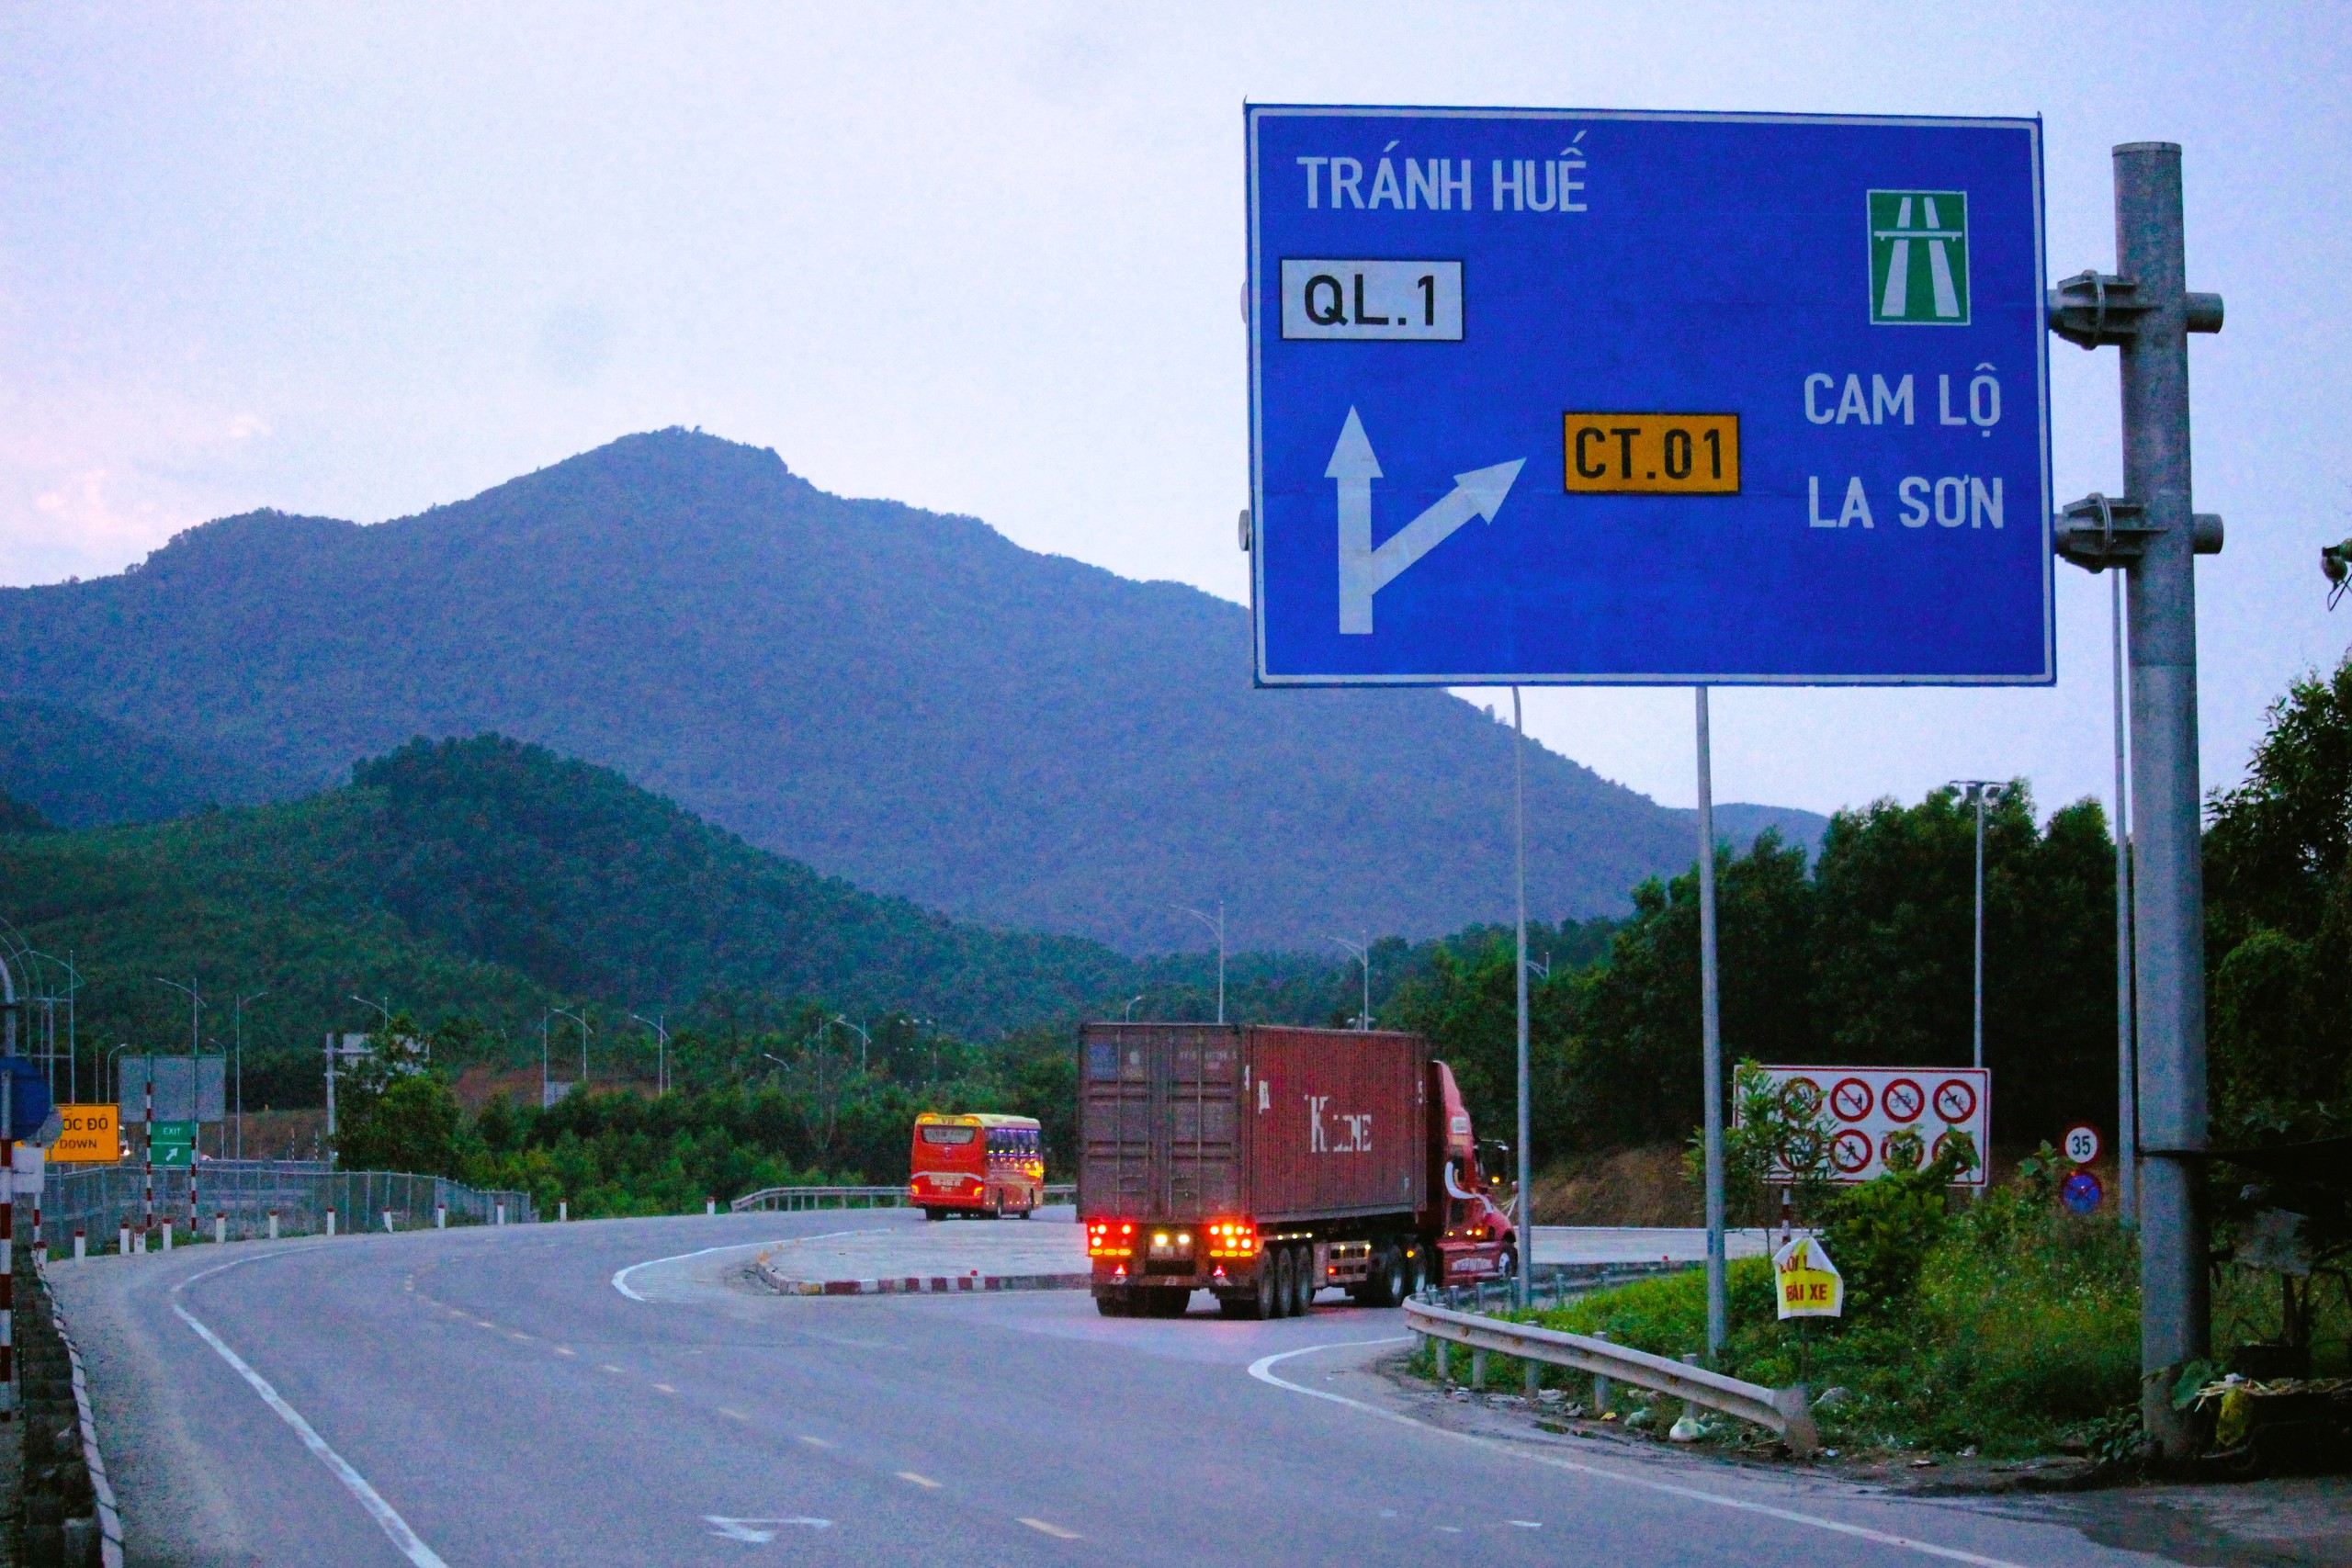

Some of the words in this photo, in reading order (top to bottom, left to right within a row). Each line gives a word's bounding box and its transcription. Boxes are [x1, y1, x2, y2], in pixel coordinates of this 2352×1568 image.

[1296, 141, 1471, 210] TRÁNH
[1492, 130, 1588, 212] HUẾ
[1305, 274, 1434, 326] QL.1
[1804, 372, 1915, 425] CAM
[1939, 362, 2001, 437] LỘ
[1576, 427, 1721, 479] CT.01
[1808, 476, 1874, 528] LA
[1898, 474, 2004, 528] SƠN
[60, 1140, 97, 1149] DOWN
[163, 1127, 181, 1135] EXIT
[2072, 1135, 2091, 1155] 35
[1809, 1283, 1827, 1301] XE
